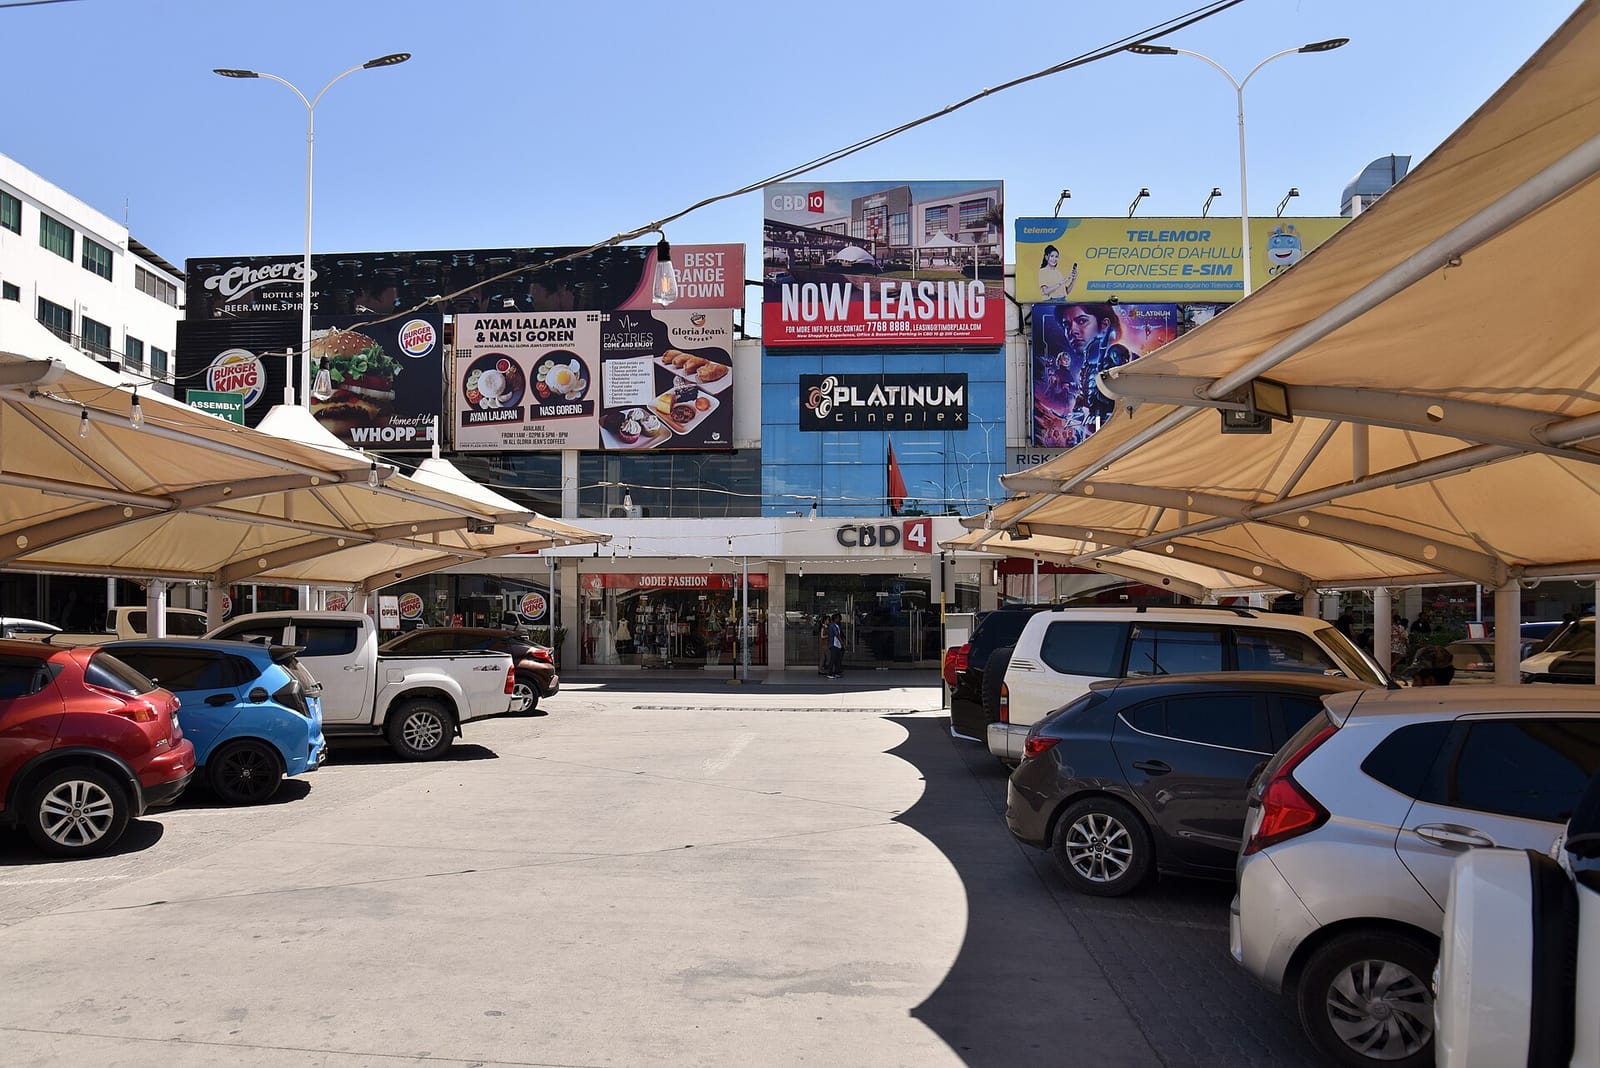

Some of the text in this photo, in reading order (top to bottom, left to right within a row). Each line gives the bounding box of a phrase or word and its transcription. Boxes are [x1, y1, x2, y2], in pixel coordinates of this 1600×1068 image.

[771, 196, 823, 211] CBD 10
[1023, 225, 1058, 234] telemor
[1127, 230, 1211, 242] TELEMOR
[1085, 244, 1177, 259] OPERADÓR
[684, 252, 725, 267] BEST
[1105, 263, 1233, 276] FORNESE E-SIM
[204, 261, 318, 296] Cheers
[677, 284, 725, 298] TOWN
[781, 280, 985, 322] NOW LEASING
[474, 318, 577, 330] AYAM LALAPAN
[404, 326, 430, 340] BURGER
[476, 331, 574, 342] & NASI GOREN
[604, 332, 654, 343] PASTRIES
[405, 333, 432, 348] KING
[214, 363, 256, 381] BURGER
[215, 372, 257, 392] KING
[833, 384, 963, 407] PLATINUM
[191, 401, 241, 410] ASSEMBLY
[540, 404, 583, 416] NASI GORENG
[389, 415, 411, 425] Home
[470, 410, 517, 422] AYAM LALAPAN
[835, 411, 963, 423] cineplex
[1016, 454, 1050, 465] RISK
[836, 523, 927, 548] CBD 4
[639, 576, 708, 587] JODIE FASHION
[401, 603, 421, 613] KING
[524, 602, 544, 613] KING
